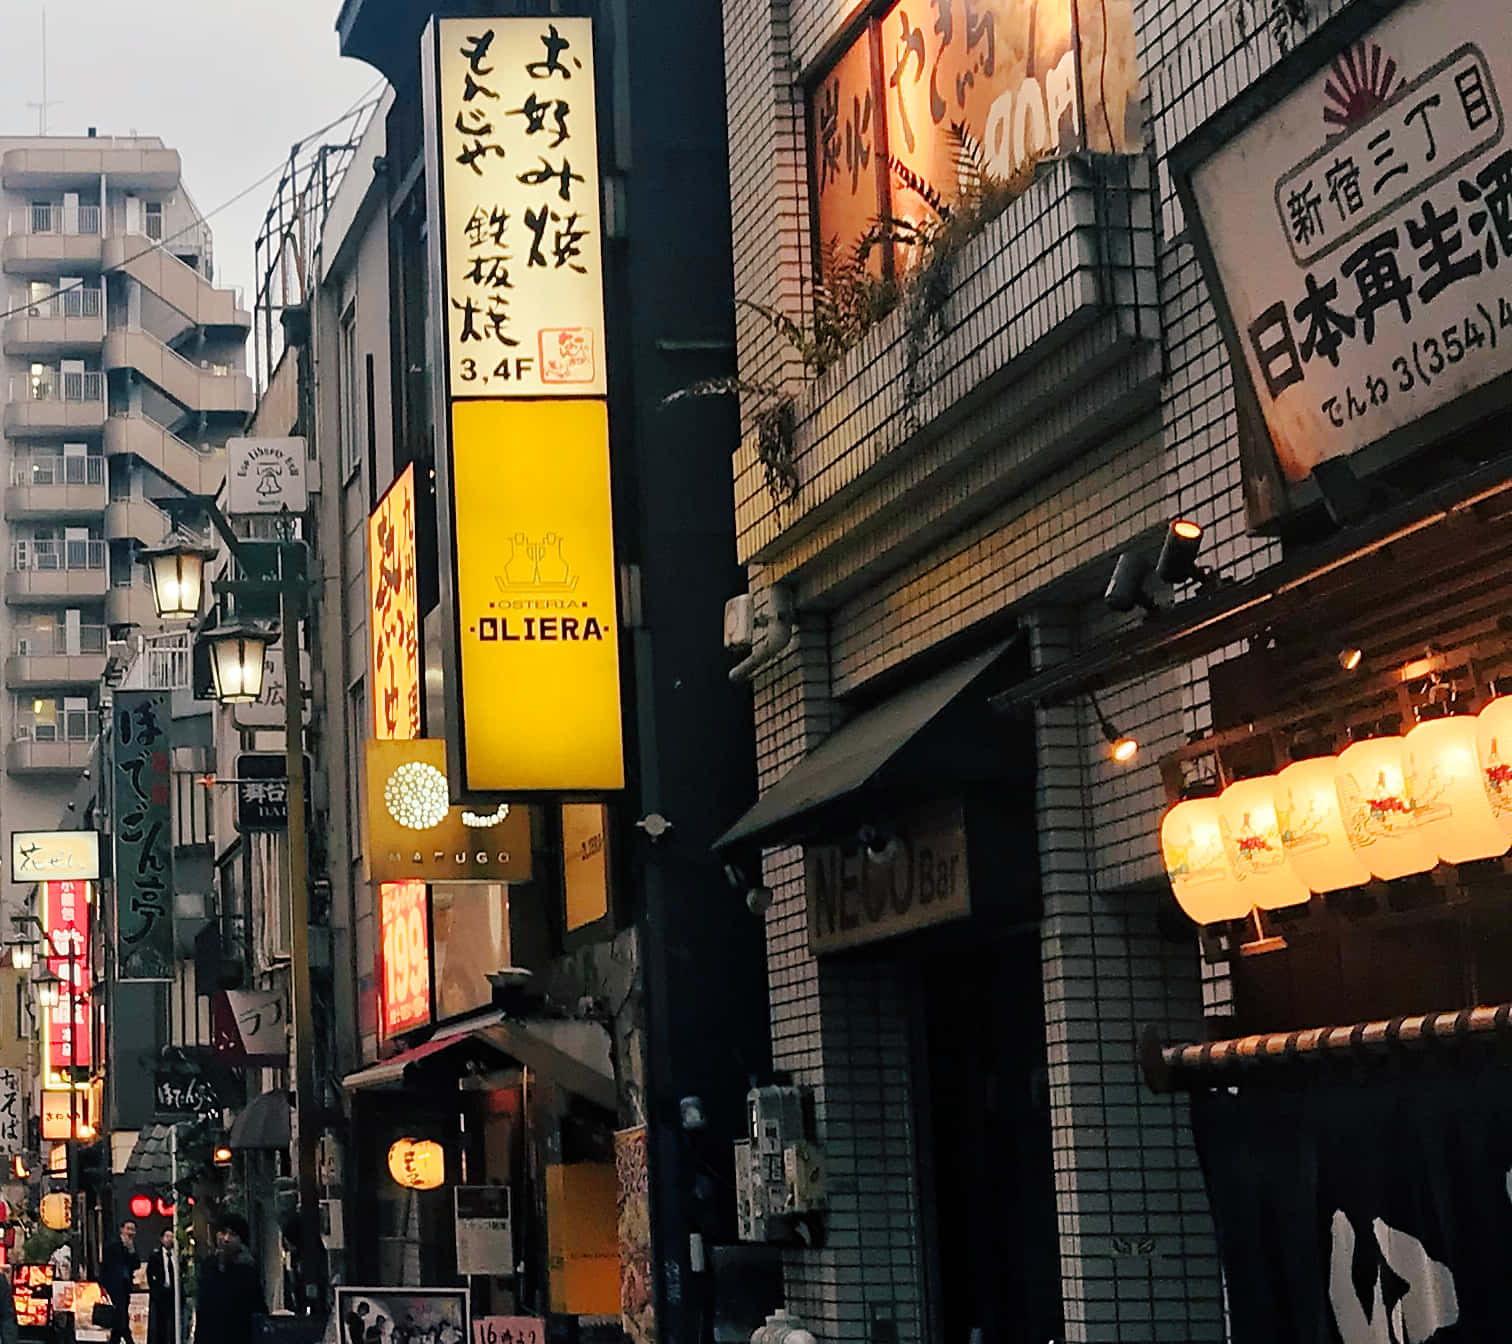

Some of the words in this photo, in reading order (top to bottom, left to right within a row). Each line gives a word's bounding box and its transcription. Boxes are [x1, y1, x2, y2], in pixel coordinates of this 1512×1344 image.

[504, 23, 591, 274] お好み焼
[1285, 63, 1494, 248] 新宿三丁目
[497, 598, 581, 611] OSTERIA
